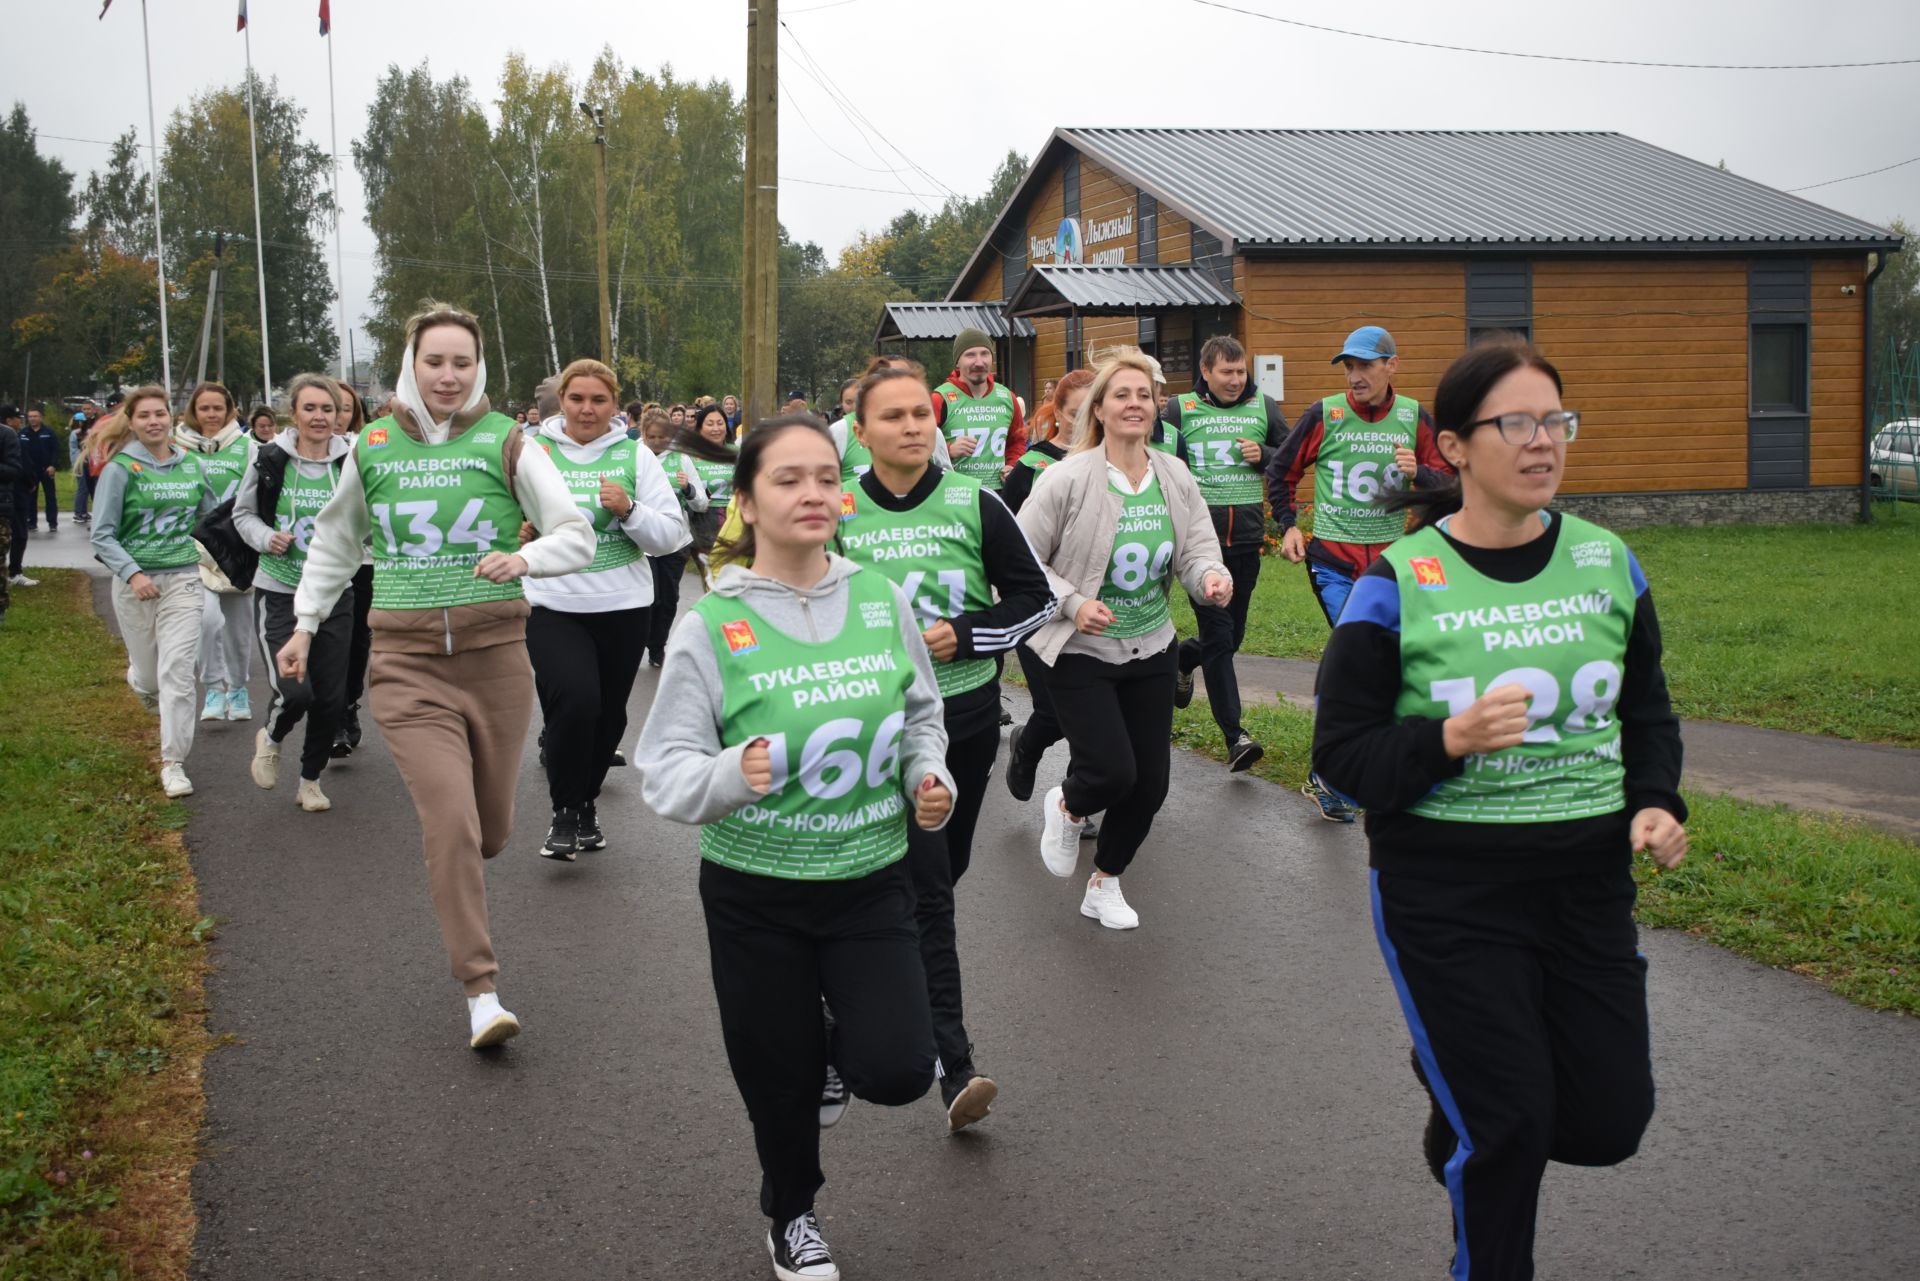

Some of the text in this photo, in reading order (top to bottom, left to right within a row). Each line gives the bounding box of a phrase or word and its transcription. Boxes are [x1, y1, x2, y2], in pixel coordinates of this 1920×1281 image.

[1085, 206, 1133, 246] Лыжный
[966, 413, 997, 422] РАЙОН
[1190, 415, 1258, 427] ТУКАЕВСКИЙ
[1205, 424, 1243, 434] РАЙОН
[1334, 432, 1409, 444] ТУКАЕВСКИЙ
[1350, 442, 1393, 454] РАЙОН
[373, 457, 488, 476] ТУКАЕВСКИЙ
[561, 466, 625, 479] АЕВСКИЙ
[136, 480, 200, 492] ТУКАЕВСКИЙ
[399, 471, 462, 490] РАЙОН
[153, 491, 190, 500] РАЙОН
[1119, 504, 1169, 519] АЕВСКИ
[371, 498, 499, 558] 134
[843, 522, 967, 550] ТУКАЕВСКИЙ
[873, 543, 941, 562] РАЙОН
[900, 569, 967, 630] 41
[1433, 588, 1613, 632] ТУКАЕВСКИЙ
[1483, 621, 1584, 652] РАЙОН
[748, 649, 897, 692] ТУКАЕВСКИЙ
[792, 679, 881, 709] РАЙОН
[794, 808, 865, 833] НОРМА
